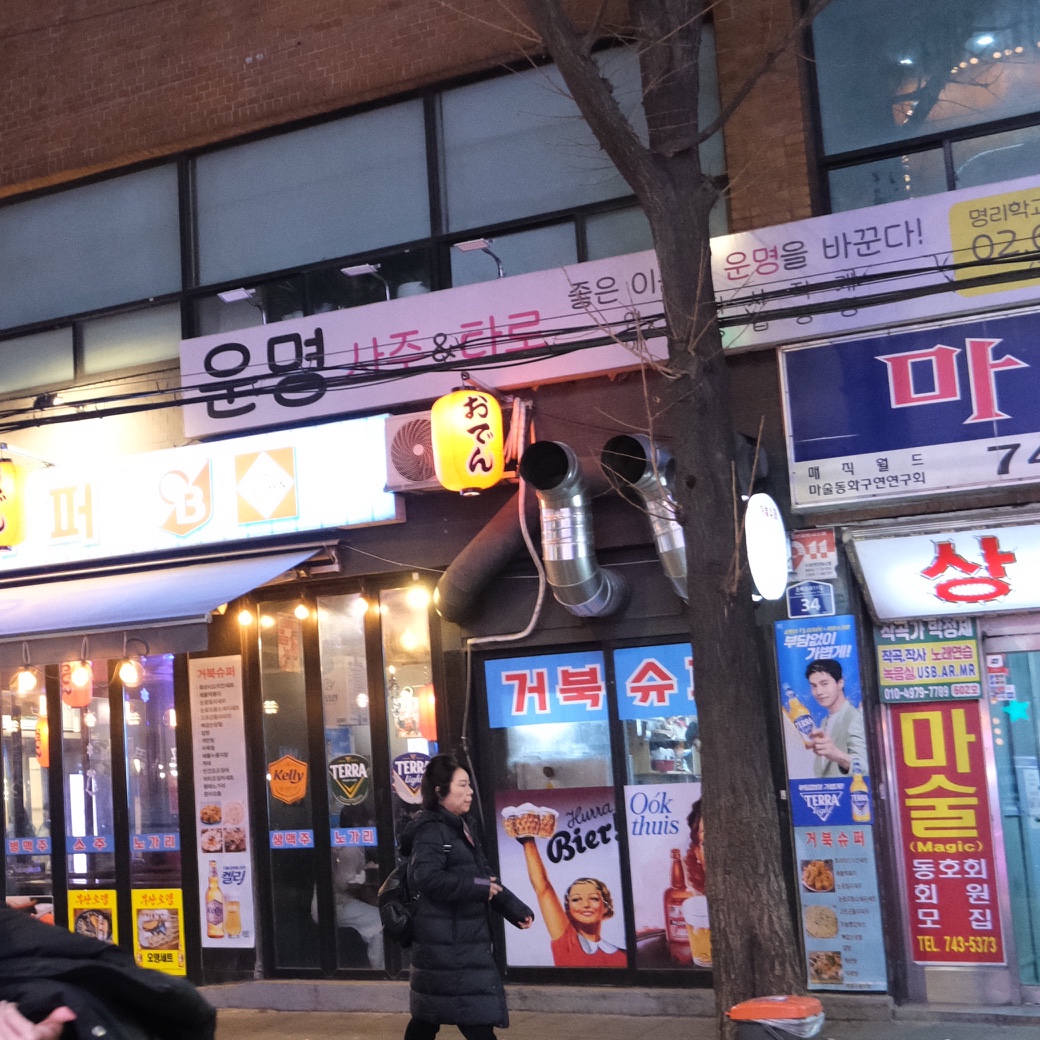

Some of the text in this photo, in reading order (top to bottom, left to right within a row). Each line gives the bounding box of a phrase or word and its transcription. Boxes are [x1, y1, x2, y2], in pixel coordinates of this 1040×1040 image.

[723, 218, 923, 282] 운명을 바꾼다!
[568, 276, 620, 310] 좋은
[198, 326, 328, 420] 운명
[874, 337, 1030, 425] 마
[463, 394, 495, 474] おでん
[808, 453, 925, 481] 매직월드
[809, 472, 926, 496] 마술동화구연연구회
[918, 534, 1018, 605] 상
[800, 598, 821, 612] 34
[784, 631, 836, 648] 부담없이
[805, 644, 852, 661] 가볍게!
[930, 644, 973, 661] 노래연습
[197, 665, 236, 680] 거북슈퍼
[883, 663, 976, 681] 녹음실 USB.AR.MR
[273, 769, 305, 785] Kelly
[329, 763, 368, 779] TERRA
[899, 708, 979, 839] 마술
[630, 792, 673, 815] Oók
[803, 794, 840, 808] TERRA
[566, 802, 613, 829] Hurra
[632, 815, 679, 836] thuis
[73, 837, 107, 850] 소주
[133, 834, 176, 849] 노가리
[272, 832, 310, 847] 생맥주
[334, 830, 374, 844] 노가리
[806, 830, 865, 848] 거북슈퍼
[910, 841, 983, 854] (Magic)
[221, 870, 246, 886] 켈리
[912, 858, 988, 881] 동호회
[914, 883, 992, 906] 회원
[917, 908, 993, 931] 모집
[944, 935, 998, 953] 743-5373
